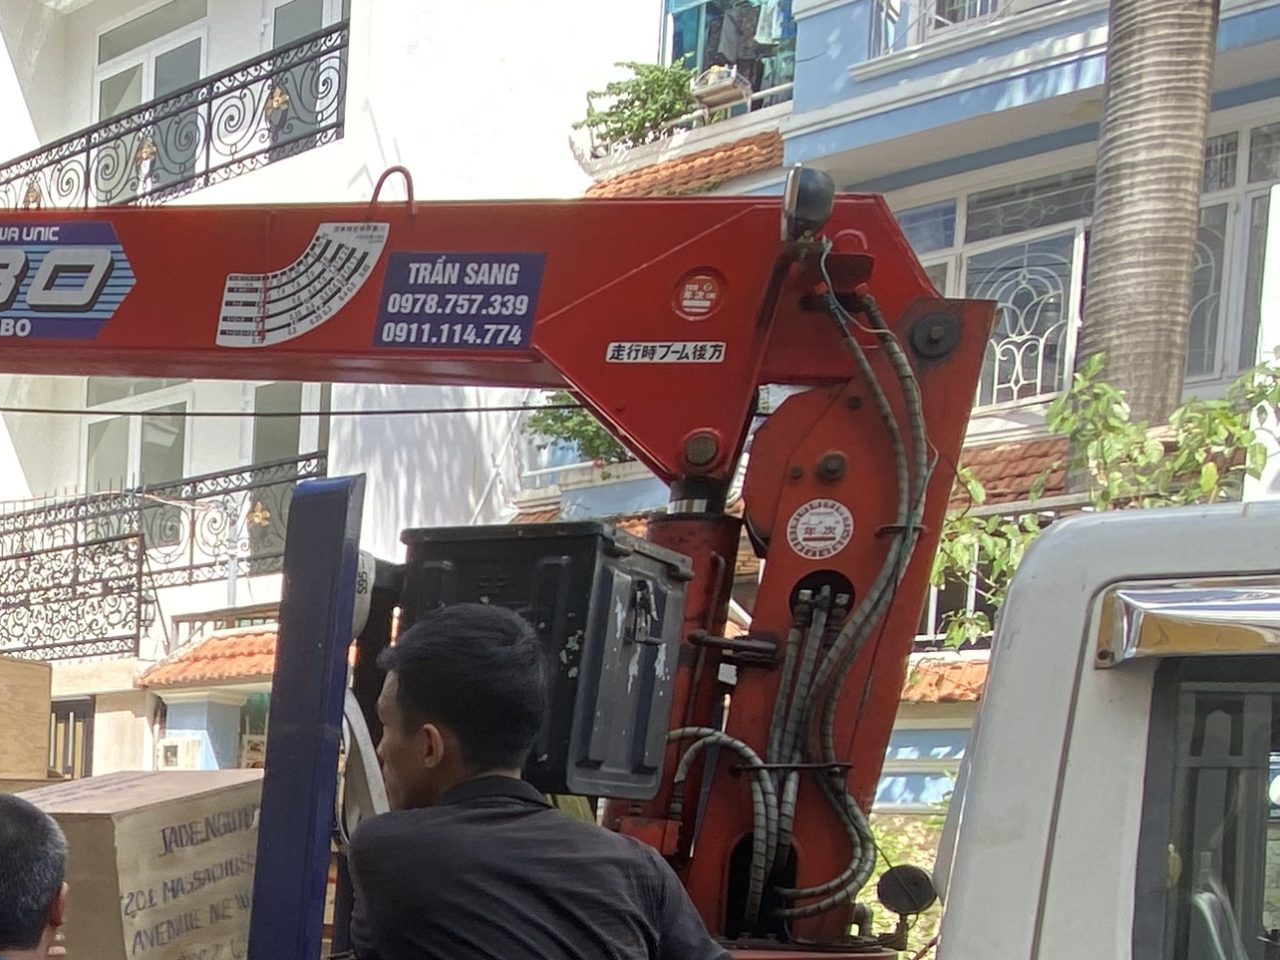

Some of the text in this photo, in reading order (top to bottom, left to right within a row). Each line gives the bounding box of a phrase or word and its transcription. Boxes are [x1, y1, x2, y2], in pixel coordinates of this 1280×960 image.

[21, 226, 60, 241] UNIC
[463, 263, 520, 285] SANG
[387, 293, 529, 315] 0978.757.339
[382, 322, 522, 345] 0911.114.774
[132, 908, 203, 955] AVENUE
